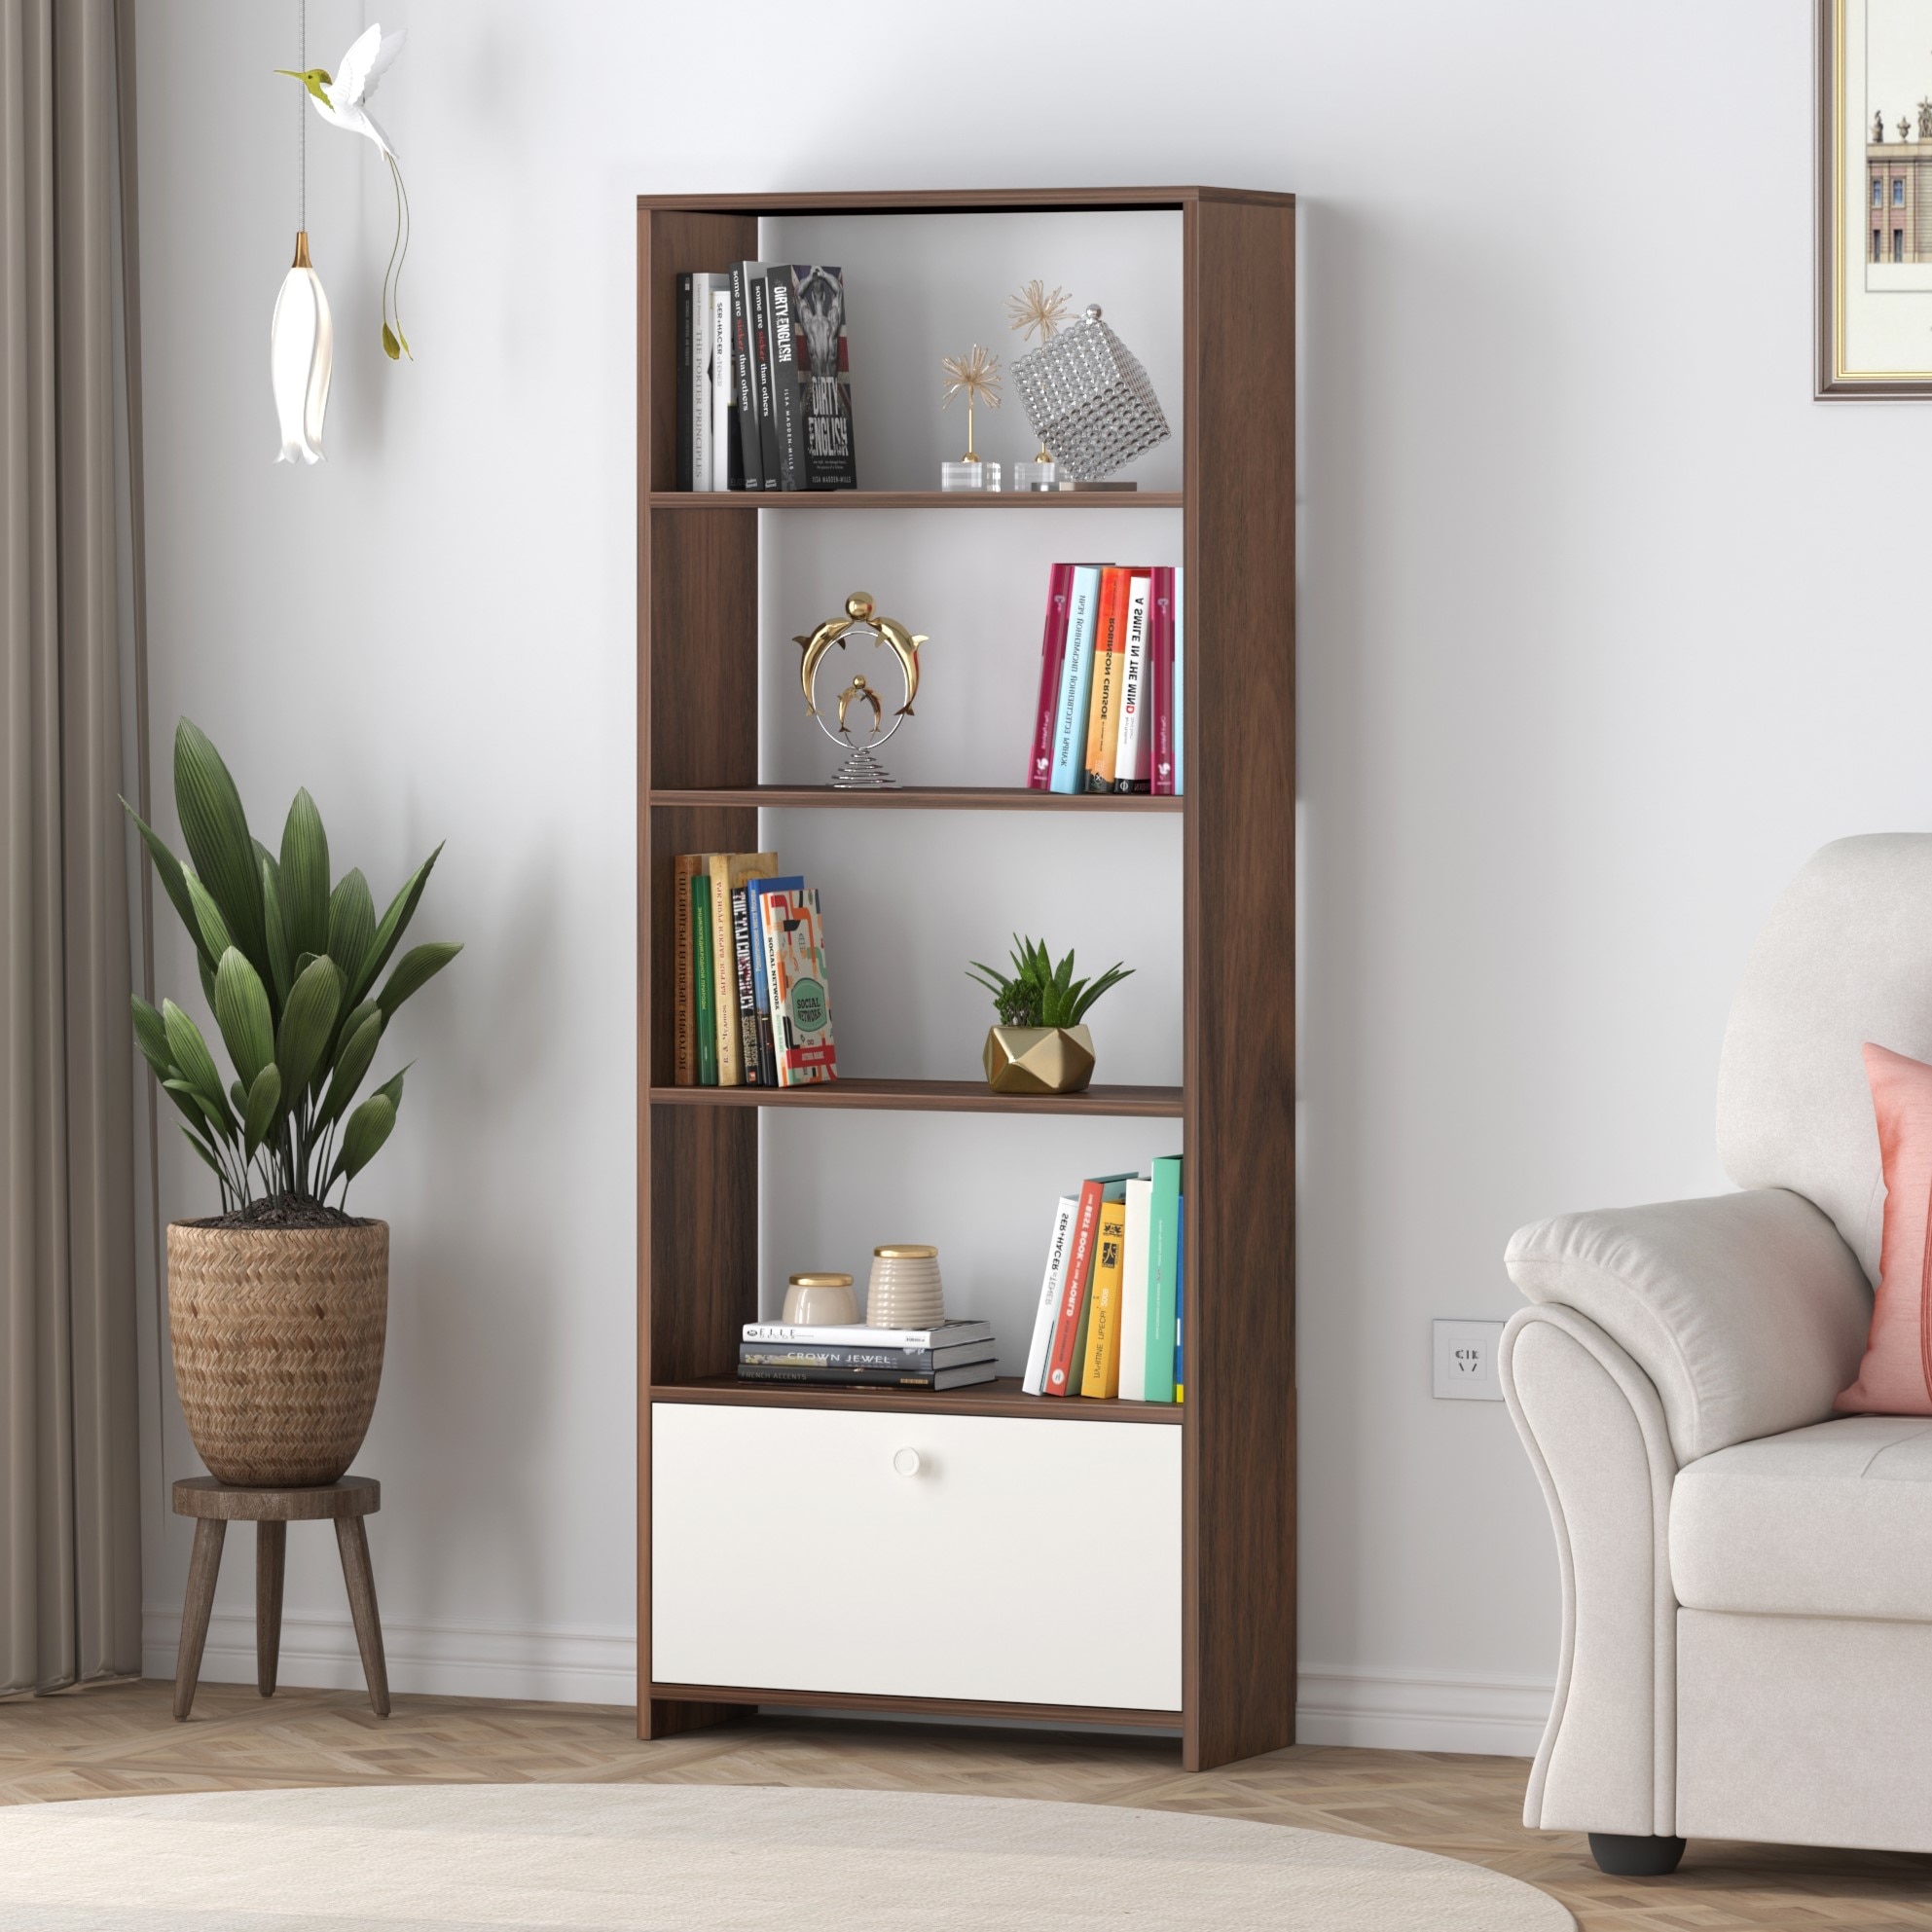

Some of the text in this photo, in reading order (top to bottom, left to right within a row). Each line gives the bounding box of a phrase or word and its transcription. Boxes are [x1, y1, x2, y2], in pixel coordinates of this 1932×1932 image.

[774, 286, 791, 363] DIRTY ENGLISH
[736, 319, 745, 351] sicker
[741, 380, 749, 412] others
[757, 330, 766, 362] sicker
[812, 376, 839, 416] DIRTY
[785, 411, 794, 470] MADDEN-MILLS
[808, 417, 849, 456] ENGLISH
[678, 896, 687, 947] ГРЕЦИИ
[735, 919, 748, 940] TAJ
[677, 950, 687, 1007] ДРЕВНЕЙ
[737, 942, 754, 1010] CONSPIRACY
[771, 970, 780, 1010] NETWORK
[796, 998, 820, 1009] SOCIAL
[798, 1008, 822, 1023] NETWORK
[742, 1016, 752, 1067] SOMESHWAR
[787, 1353, 891, 1364] CROWN JEWEL
